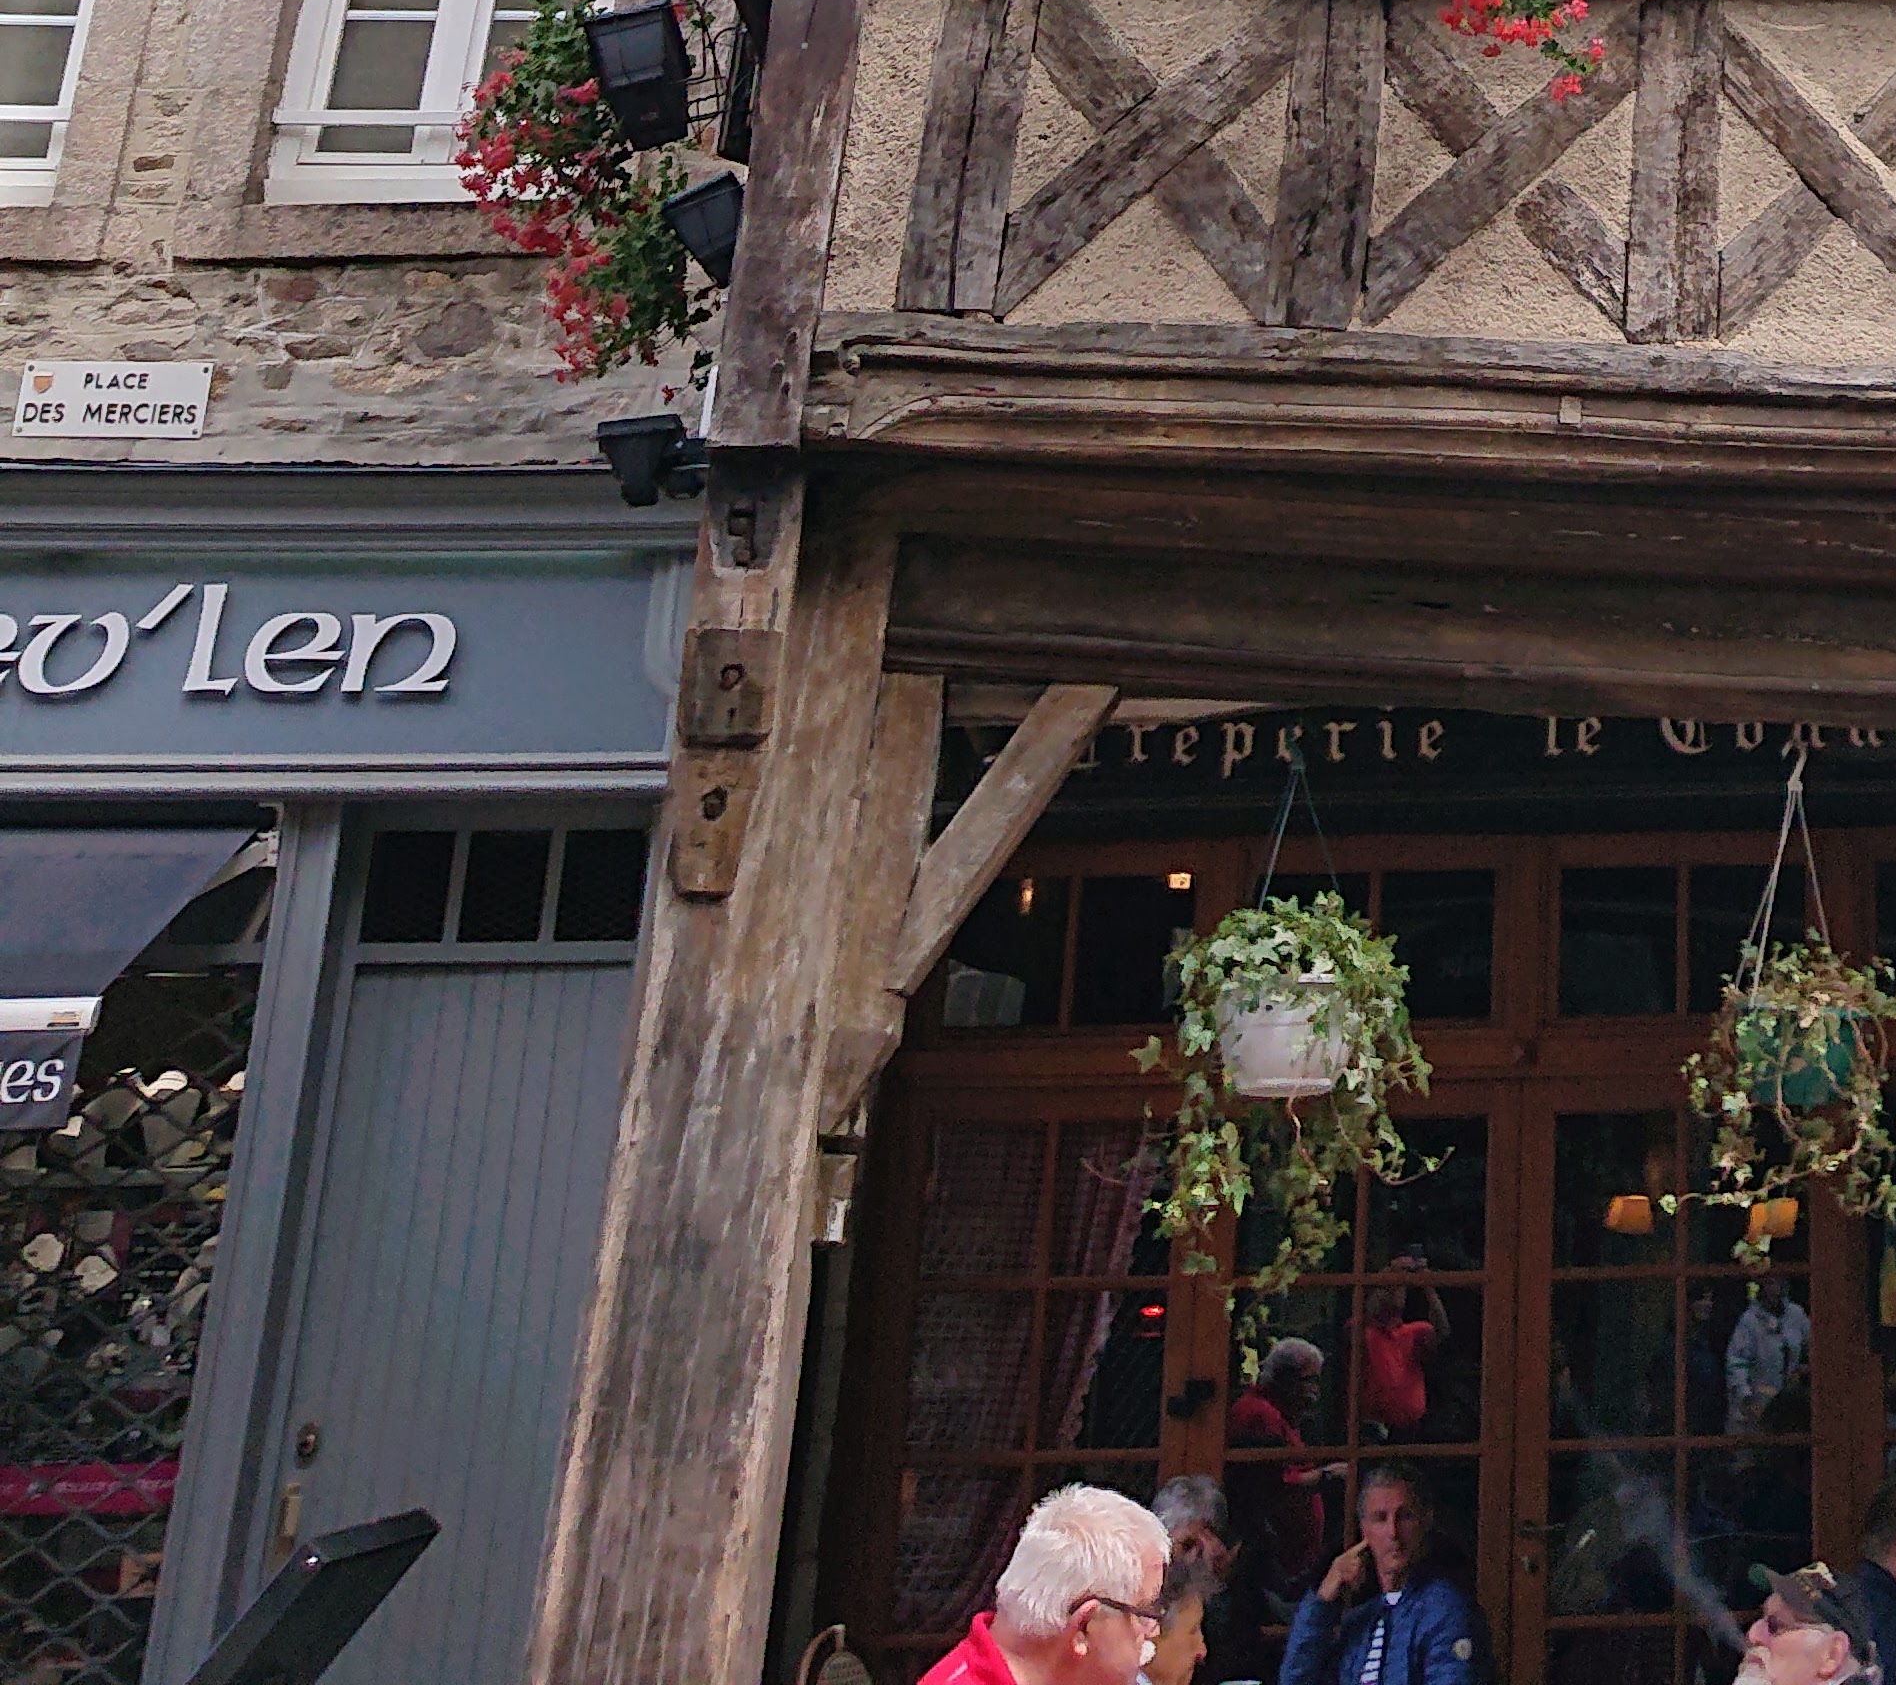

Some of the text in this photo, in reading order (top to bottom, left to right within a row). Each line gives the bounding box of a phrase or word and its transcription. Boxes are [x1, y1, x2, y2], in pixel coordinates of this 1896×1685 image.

[83, 372, 150, 390] PLACE
[22, 402, 198, 425] DES MERCIERS
[1069, 709, 1446, 779] reperie
[0, 1059, 64, 1104] es
